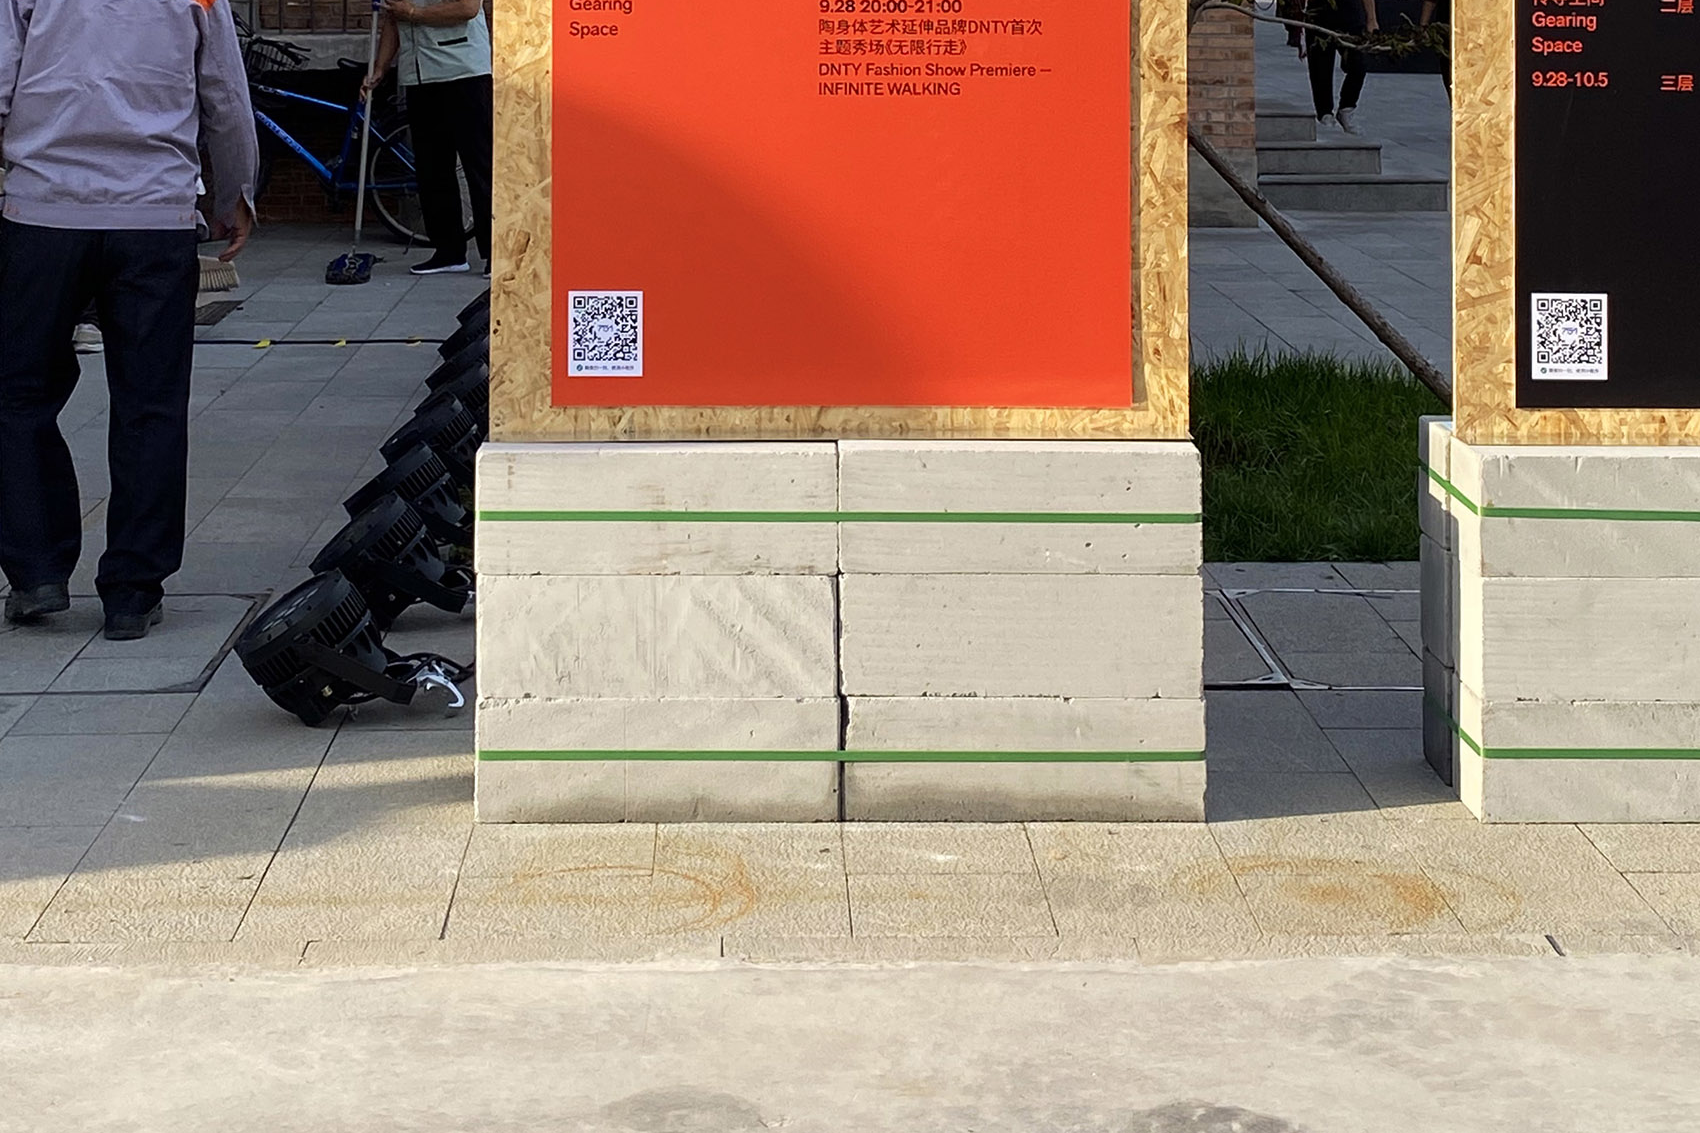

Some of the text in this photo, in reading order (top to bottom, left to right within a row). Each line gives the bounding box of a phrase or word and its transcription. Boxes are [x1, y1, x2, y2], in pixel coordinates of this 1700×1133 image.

[819, 0, 963, 14] 9.28 20:00-21:00
[569, 20, 619, 39] Space
[818, 18, 1043, 36] 陶身体艺术延伸品牌DNTY首次
[1531, 11, 1598, 32] Gearing
[818, 39, 968, 56] 主题秀场《无限行走》
[1531, 36, 1583, 56] Space
[818, 62, 862, 76] DNTY
[866, 62, 921, 76] Fashion
[925, 62, 966, 77] Show
[970, 62, 1037, 77] Premiere
[1531, 71, 1609, 87] 9.28-10.5
[1660, 74, 1695, 92] 三层
[818, 82, 961, 96] INFINITE WALKING
